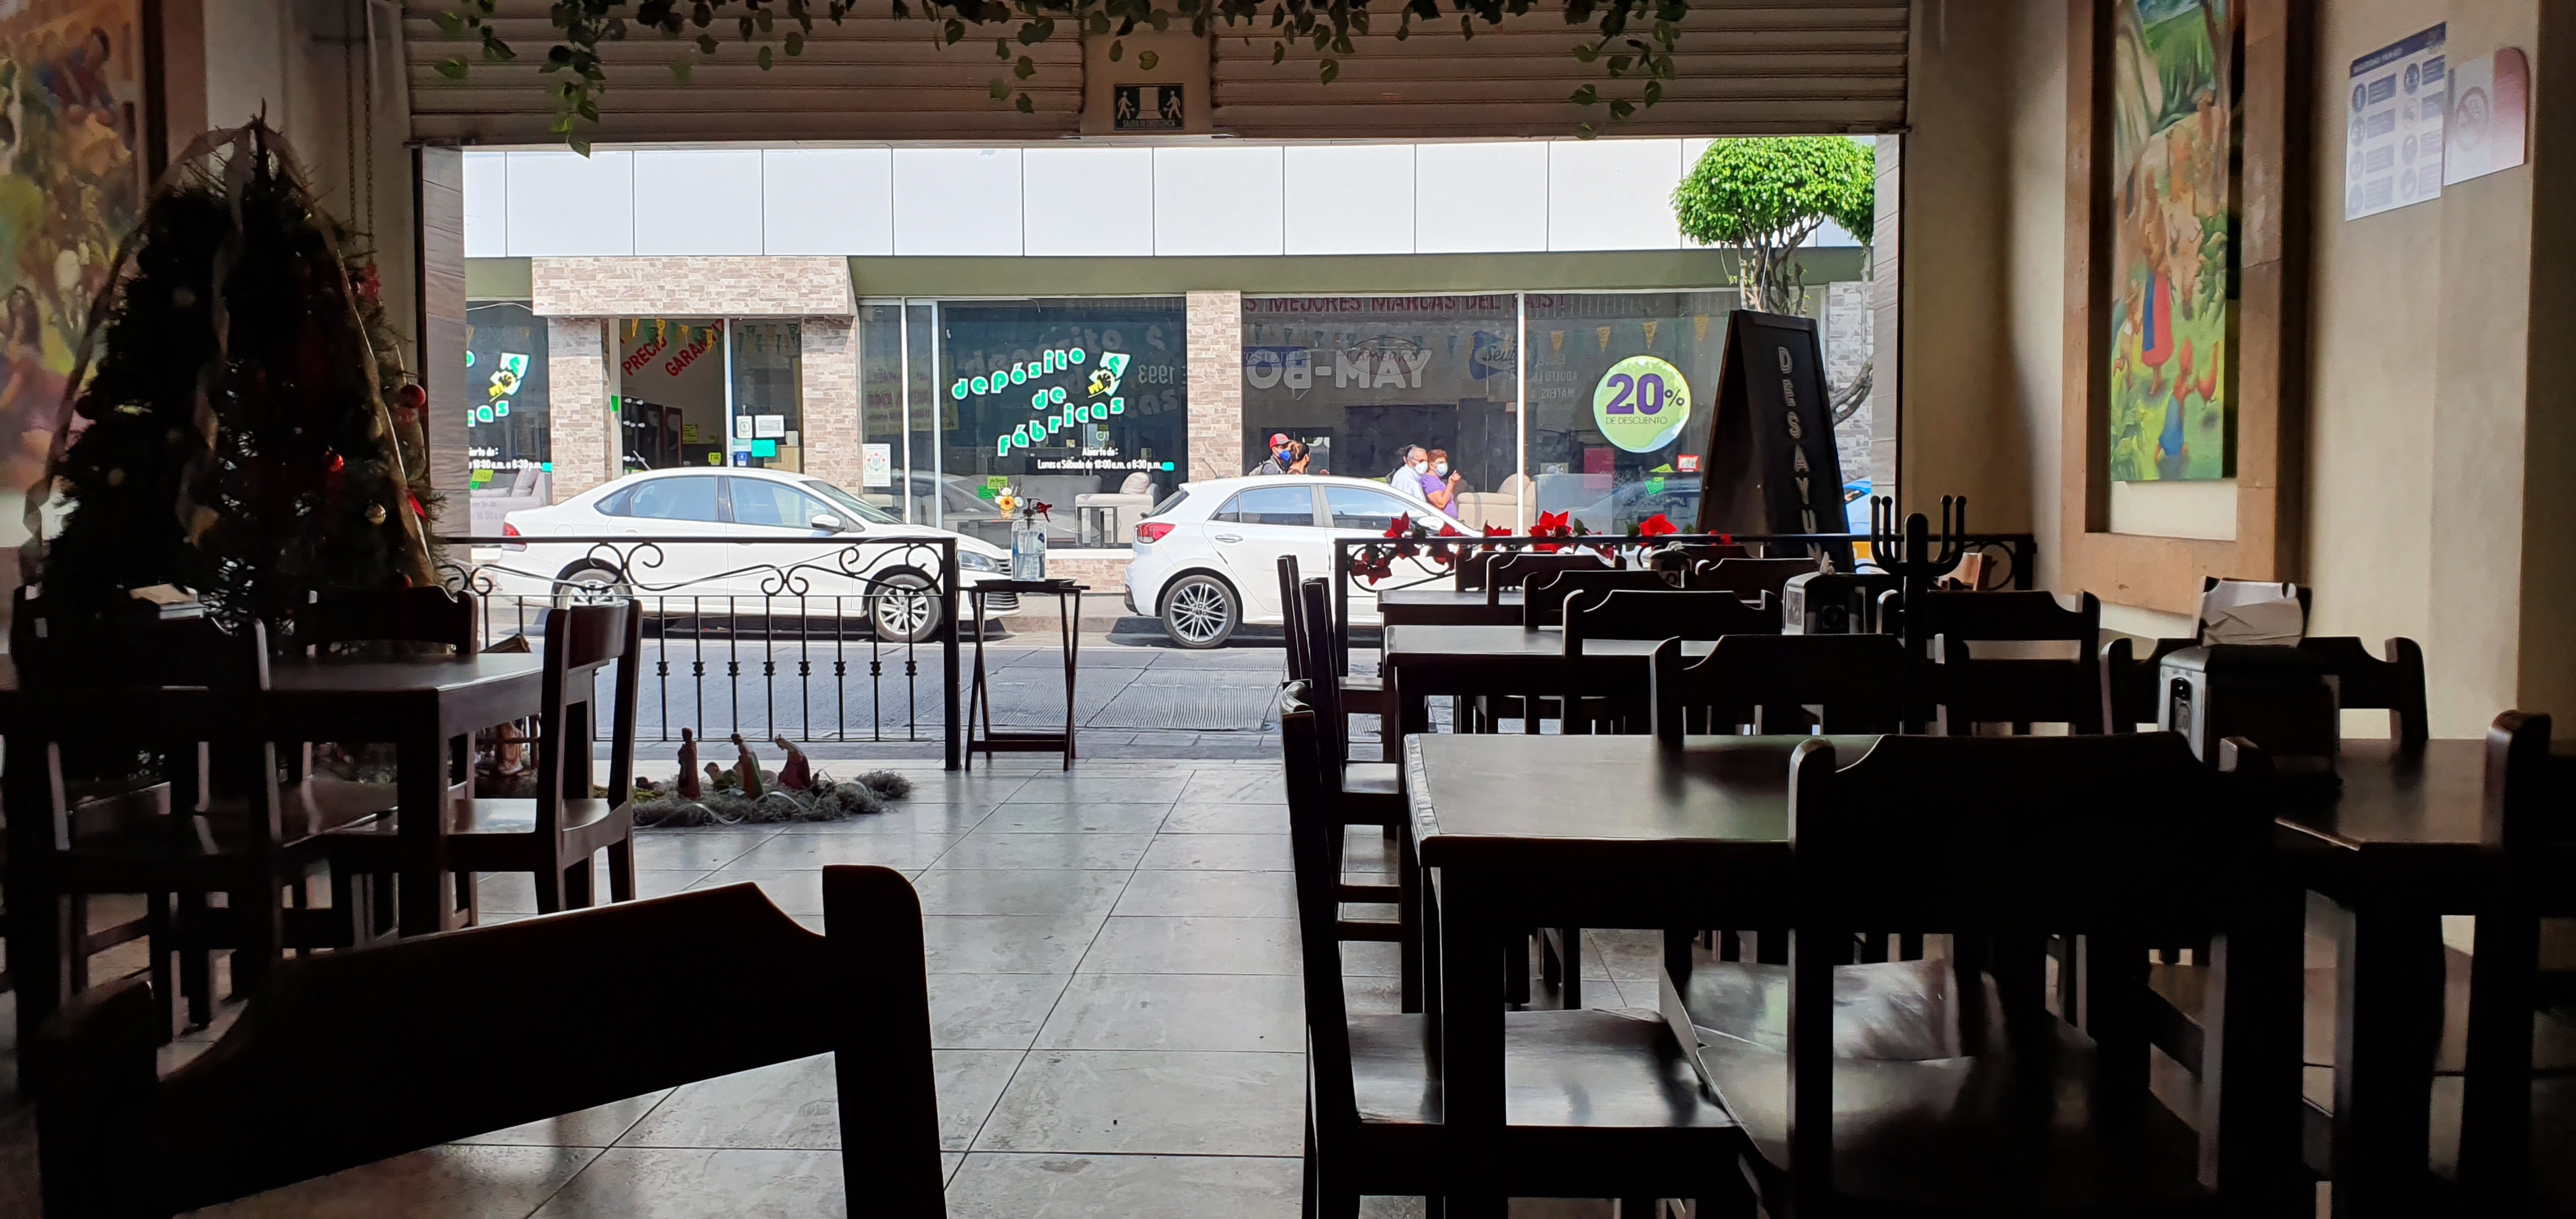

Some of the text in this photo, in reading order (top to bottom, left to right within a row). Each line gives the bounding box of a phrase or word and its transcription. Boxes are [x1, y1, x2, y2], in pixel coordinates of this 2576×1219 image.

[1269, 297, 1361, 312] MEJORES
[1372, 296, 1455, 311] MARCAS
[952, 348, 1086, 400] depósito
[1032, 387, 1067, 410] de
[1606, 372, 1685, 415] 20%
[997, 397, 1125, 457] fábricas
[1606, 416, 1668, 425] DE DESCUENTO
[469, 447, 486, 456] ierto
[1082, 447, 1106, 456] Abierto
[472, 459, 491, 469] 10:00
[512, 459, 528, 469] 6:30
[1037, 459, 1056, 470] Lunes
[1094, 459, 1112, 470] 10:00
[1132, 459, 1147, 470] 6:30
